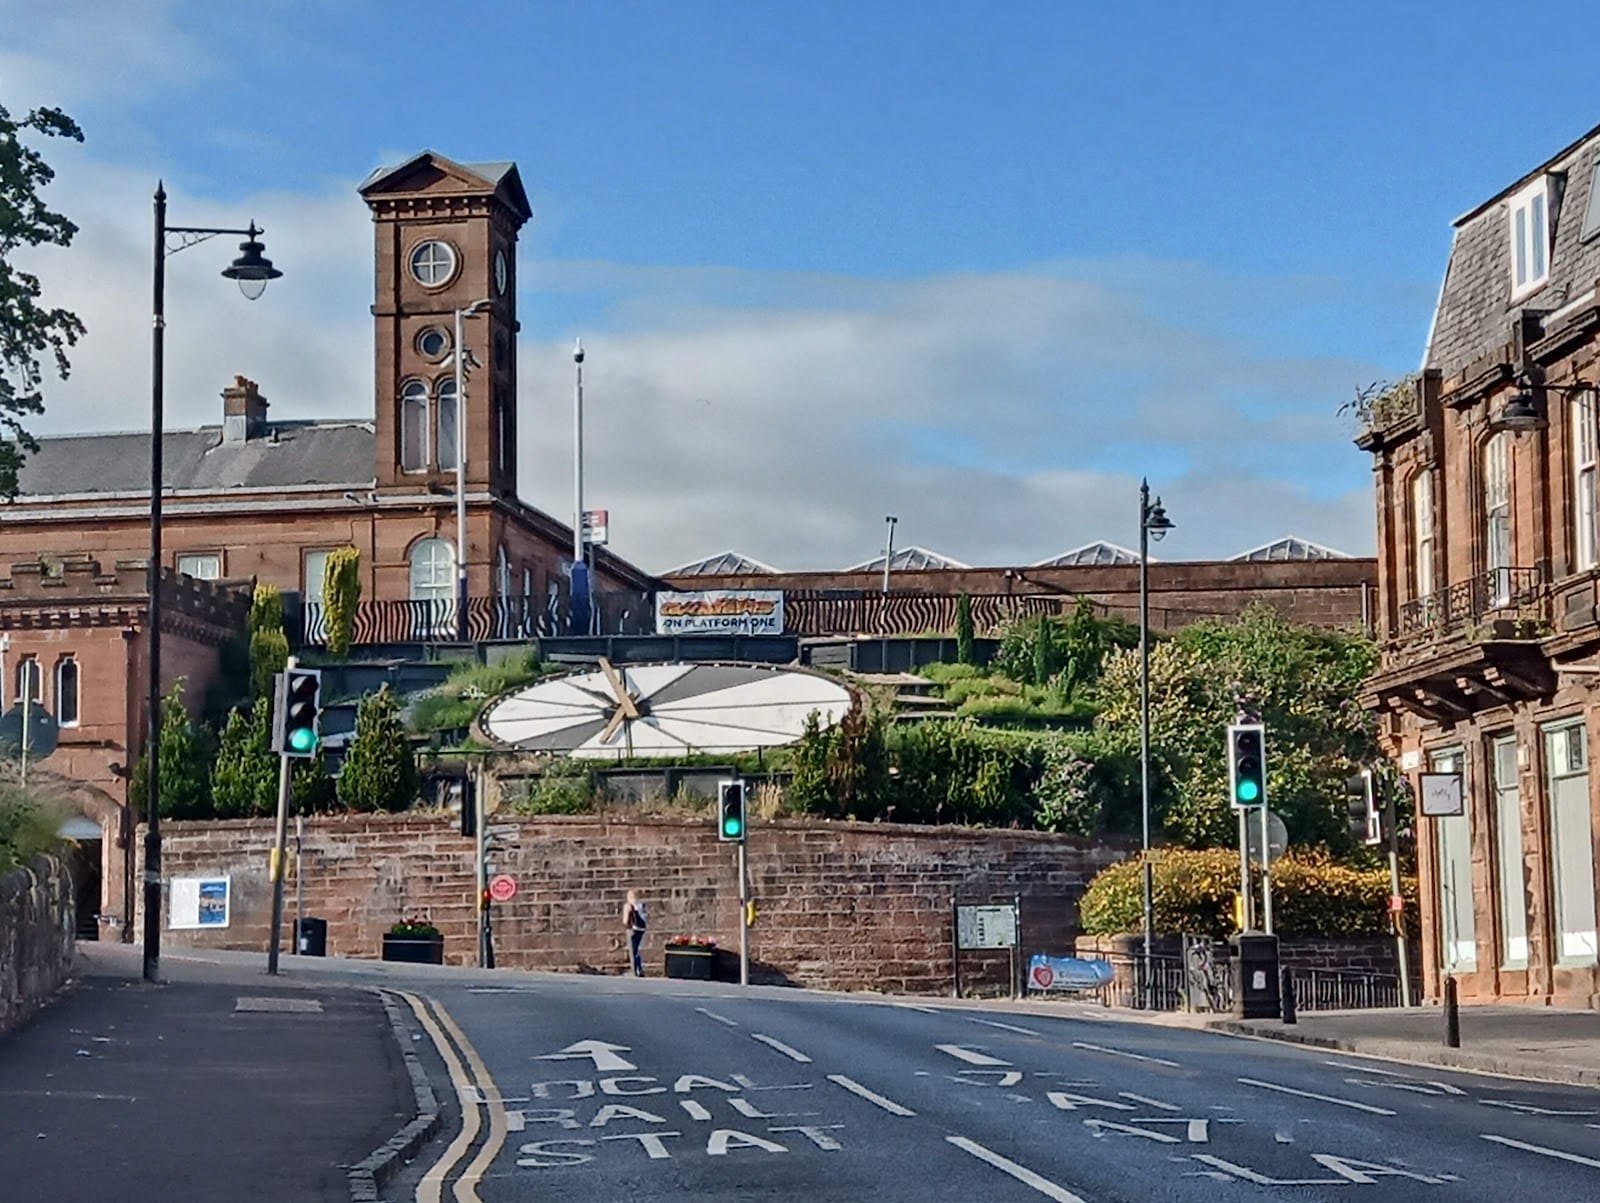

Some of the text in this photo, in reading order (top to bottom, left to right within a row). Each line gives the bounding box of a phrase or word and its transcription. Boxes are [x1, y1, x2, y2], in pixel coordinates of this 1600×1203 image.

[664, 618, 775, 628] ON PLATFORM ONE
[505, 1098, 822, 1132] RAIL
[516, 1124, 846, 1167] STAT
